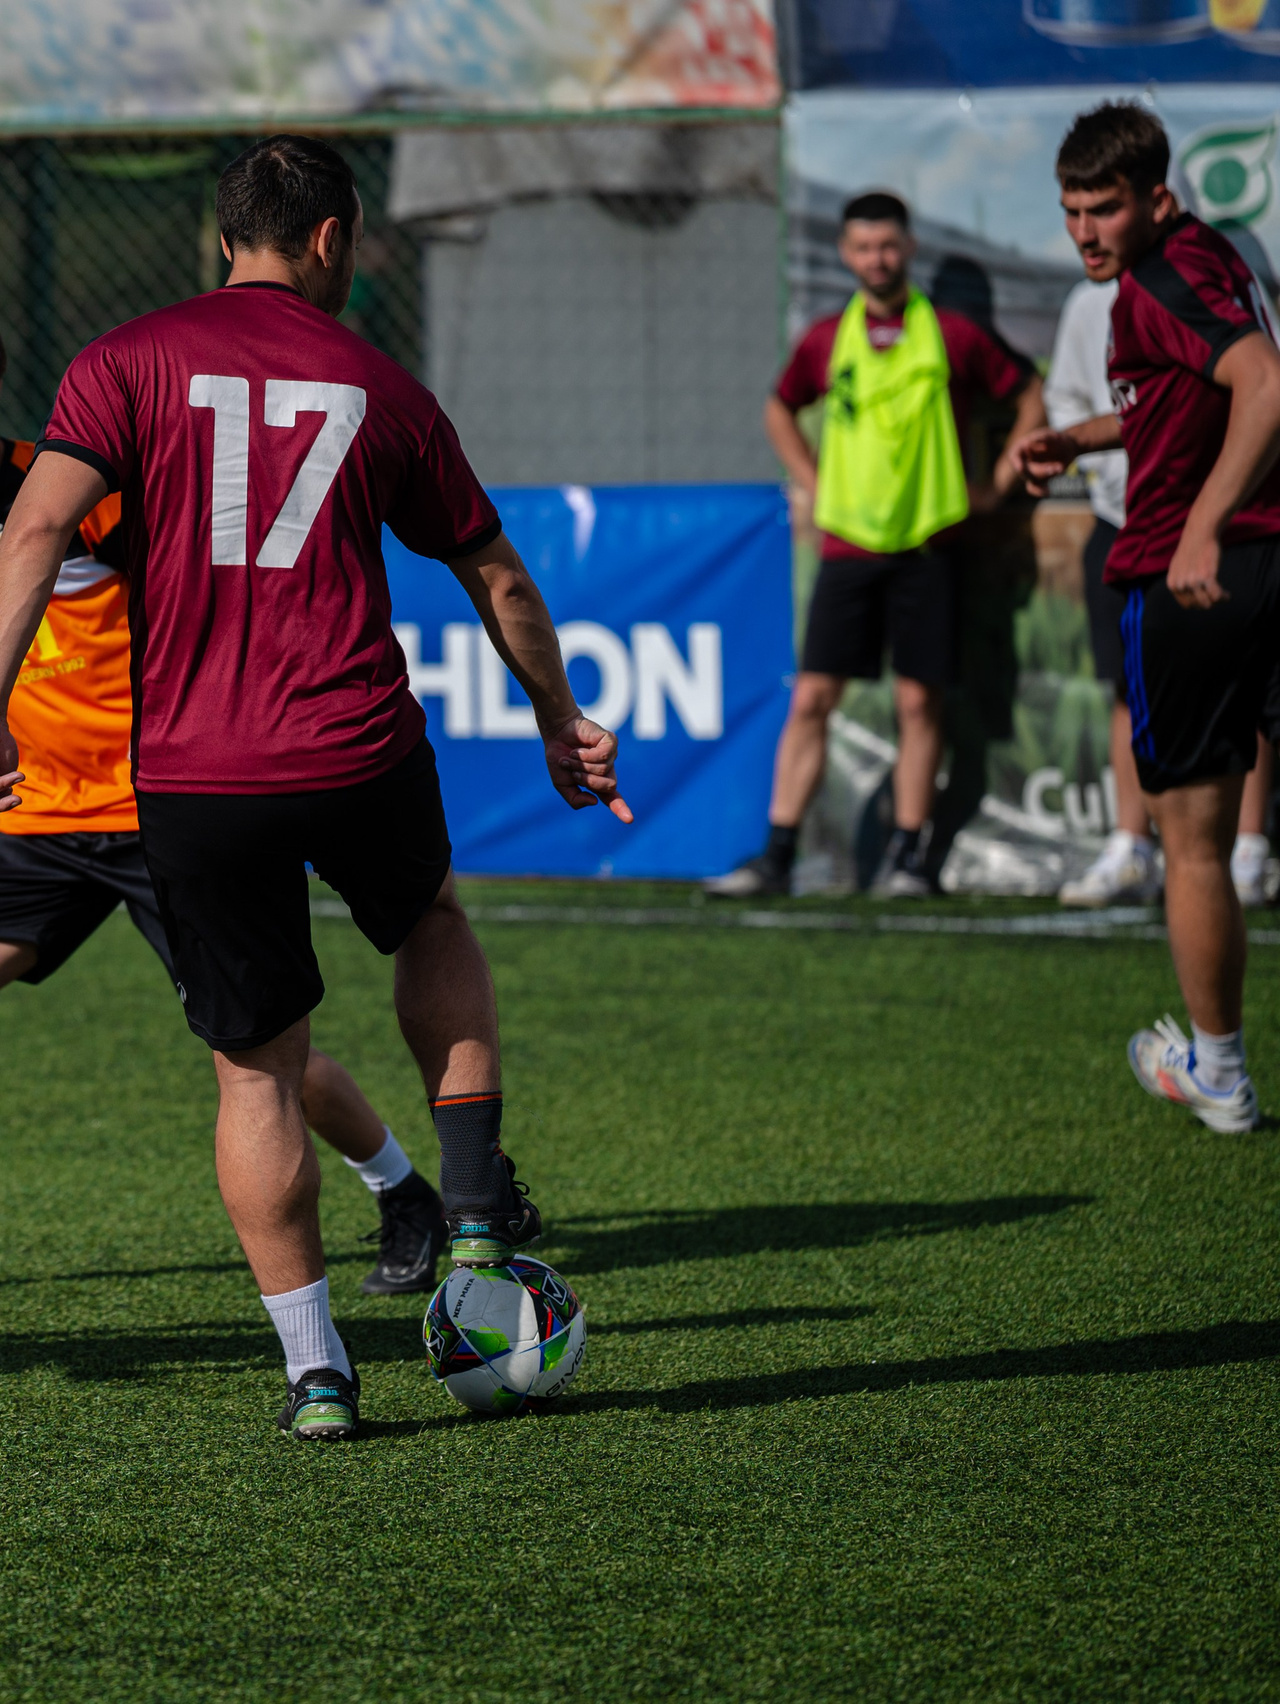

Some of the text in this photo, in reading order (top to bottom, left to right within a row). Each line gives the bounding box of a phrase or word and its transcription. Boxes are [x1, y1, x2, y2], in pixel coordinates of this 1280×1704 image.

[188, 374, 367, 569] 17
[392, 620, 723, 741] HLON
[1022, 766, 1118, 834] Cul
[453, 1278, 475, 1319] NEW MAYA
